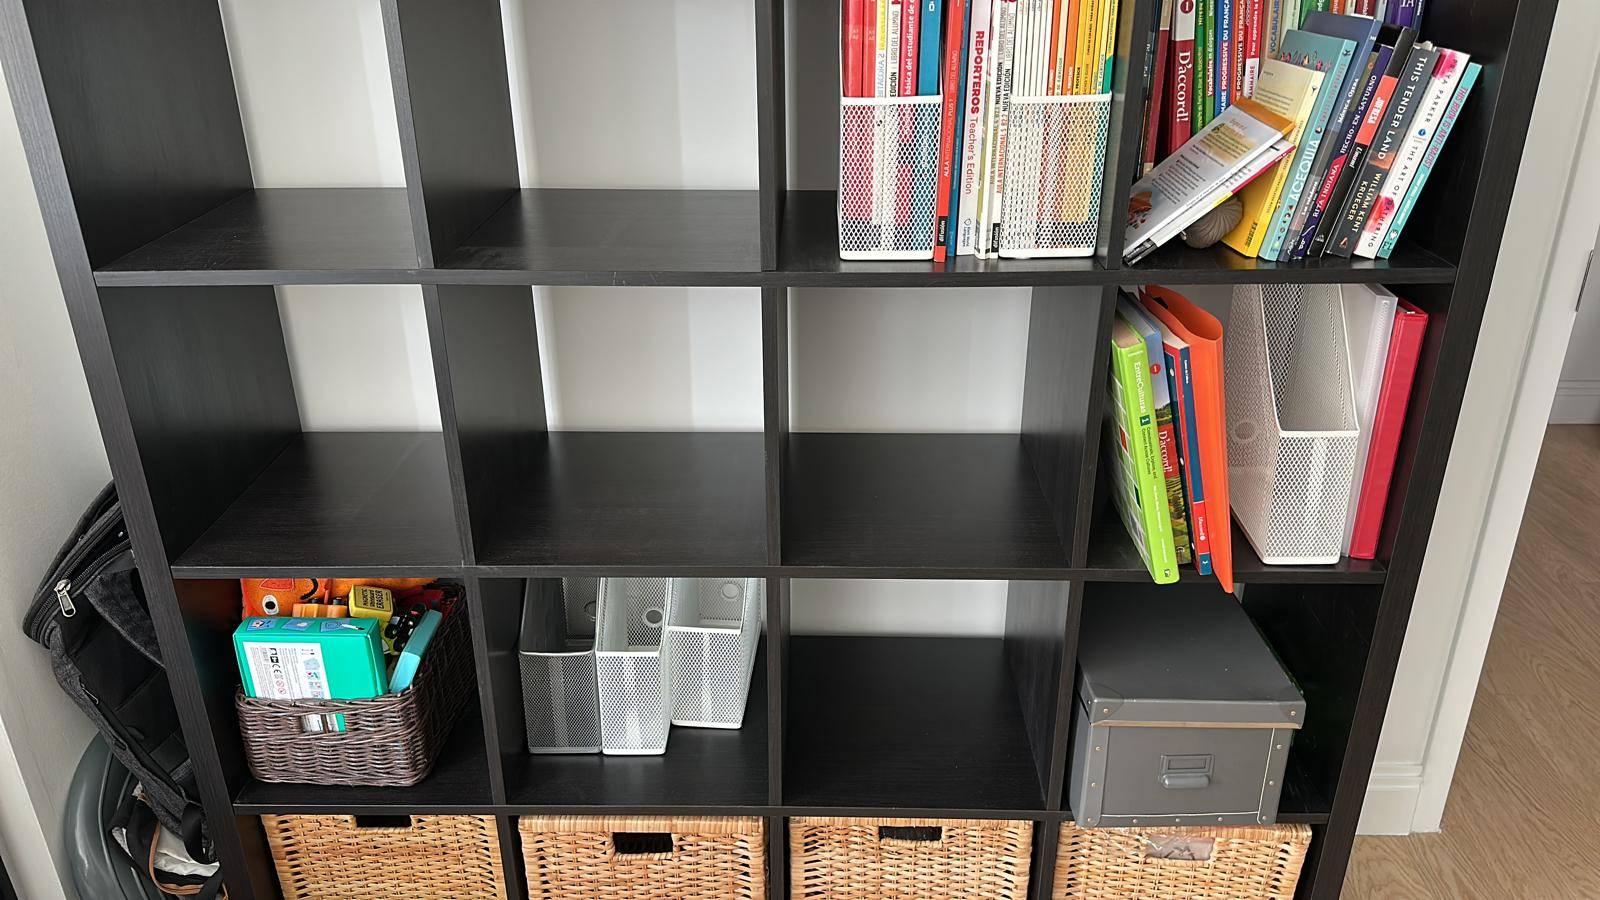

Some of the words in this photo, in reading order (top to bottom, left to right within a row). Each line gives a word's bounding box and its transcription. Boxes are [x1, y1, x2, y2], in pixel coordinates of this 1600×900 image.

[908, 6, 915, 15] de
[1270, 0, 1279, 53] VOCABULAIR
[907, 21, 915, 56] estudiante
[1223, 30, 1229, 41] DU
[1238, 31, 1244, 42] DU
[904, 71, 912, 95] básica
[971, 31, 985, 114] REPORTEROS
[1003, 68, 1011, 92] EDICIÓN
[1176, 51, 1192, 122] D'accord!
[1410, 57, 1428, 82] THIS
[1359, 75, 1377, 110] SATURNO
[1390, 85, 1416, 128] TENDER
[1425, 89, 1444, 123] PARKER
[968, 117, 978, 161] Teacher's
[1378, 130, 1395, 160] LAND
[1409, 146, 1418, 161] THE
[965, 163, 975, 194] Edition
[1289, 140, 1320, 201] ACEQUIA
[1400, 165, 1409, 182] ART
[1312, 199, 1325, 218] RITA
[1321, 164, 1340, 198] INDIANA
[1347, 180, 1368, 221] KRUEGER
[1361, 173, 1382, 209] WILLIAM
[1392, 185, 1400, 196] OF
[1351, 210, 1366, 233] KENT
[1368, 199, 1393, 248] GATHERING
[1134, 361, 1146, 414] EntreCulturas
[1159, 430, 1173, 473] D'accord!
